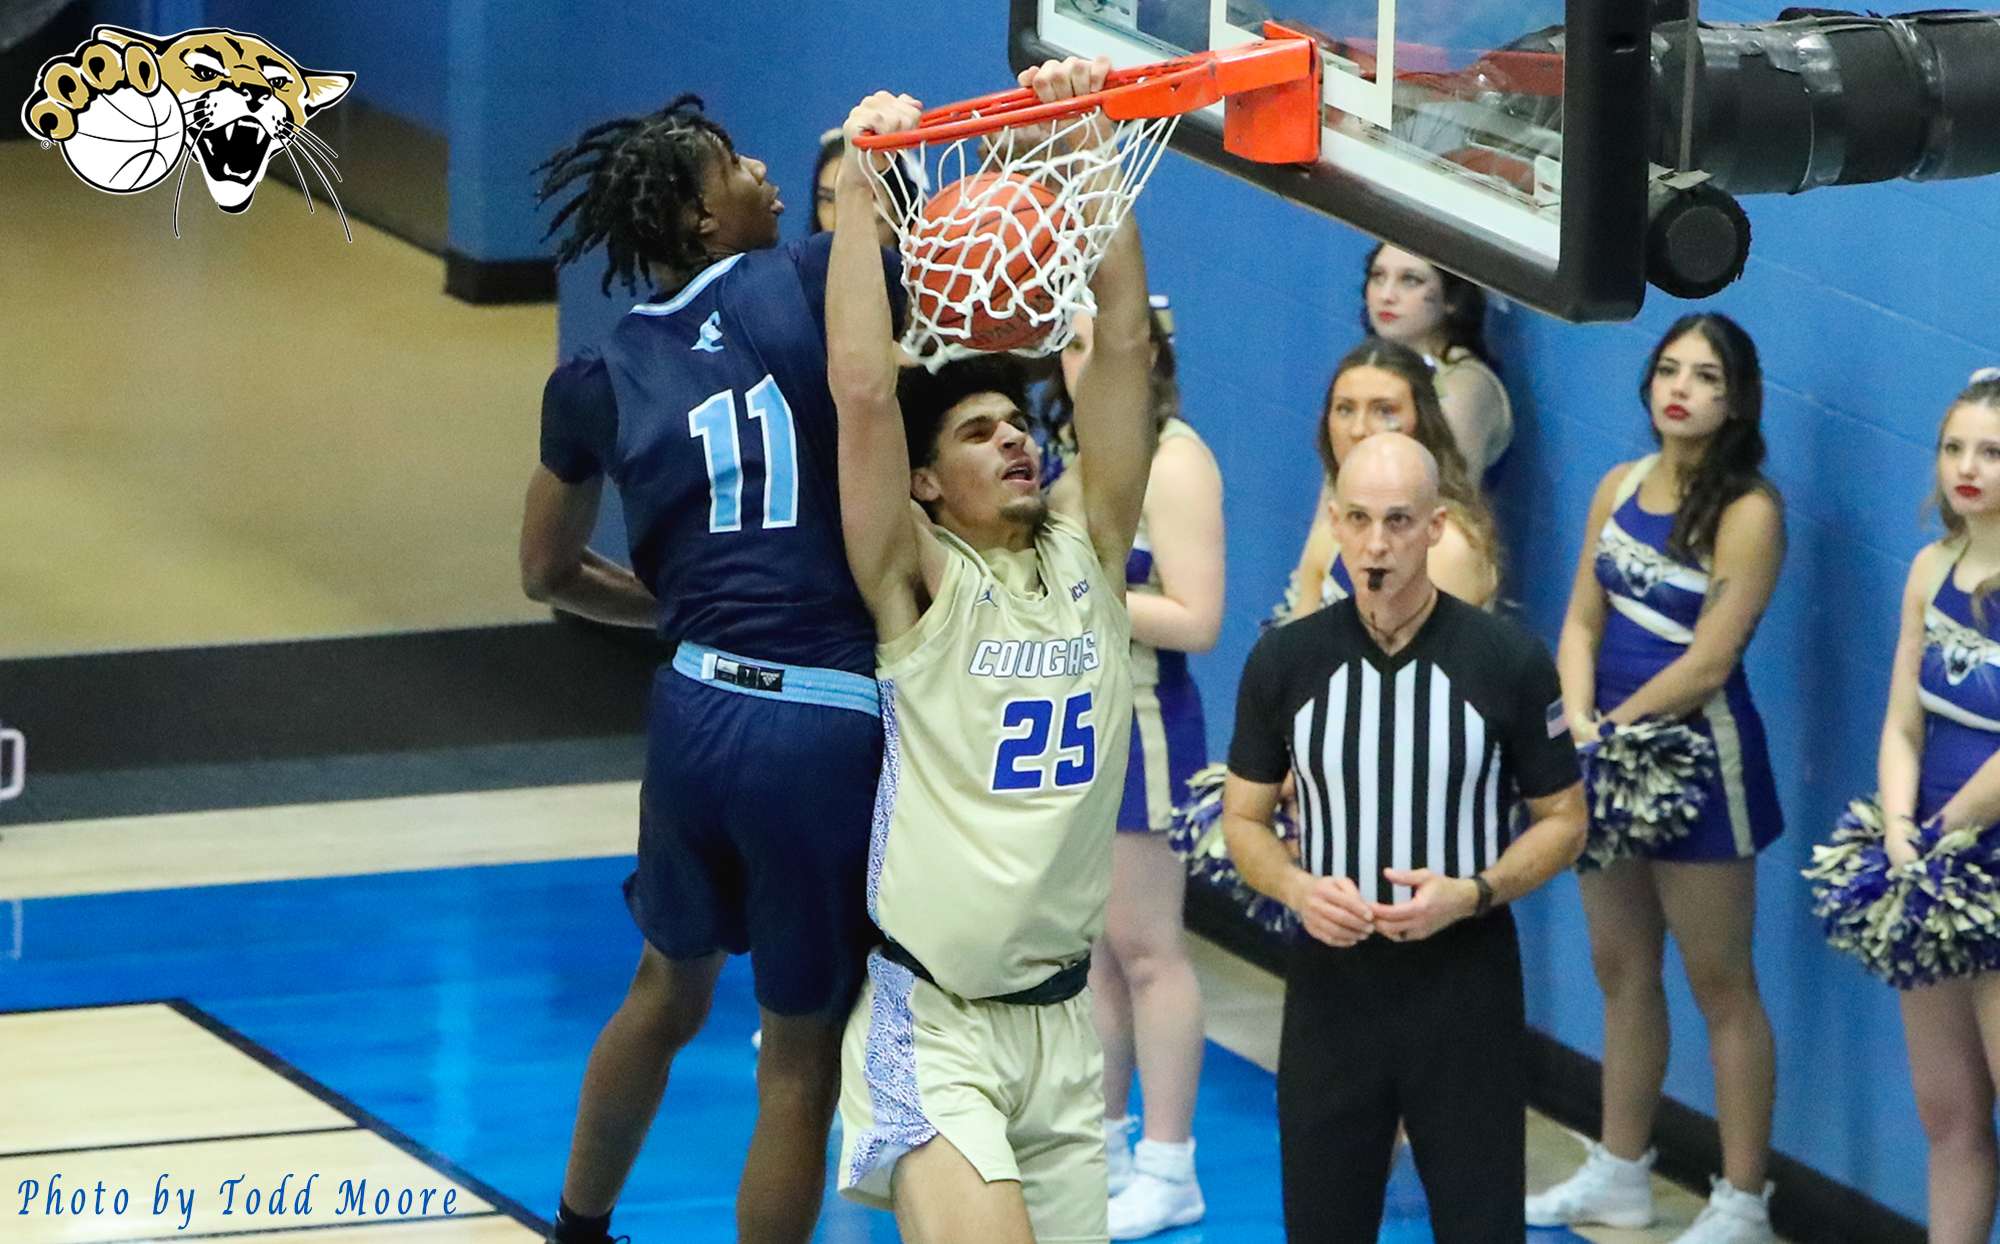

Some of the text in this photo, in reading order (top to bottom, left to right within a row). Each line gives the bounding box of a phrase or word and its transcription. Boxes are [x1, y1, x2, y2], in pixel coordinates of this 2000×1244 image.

[688, 373, 799, 533] 11
[968, 631, 1099, 678] COUGAS
[990, 690, 1096, 793] 25
